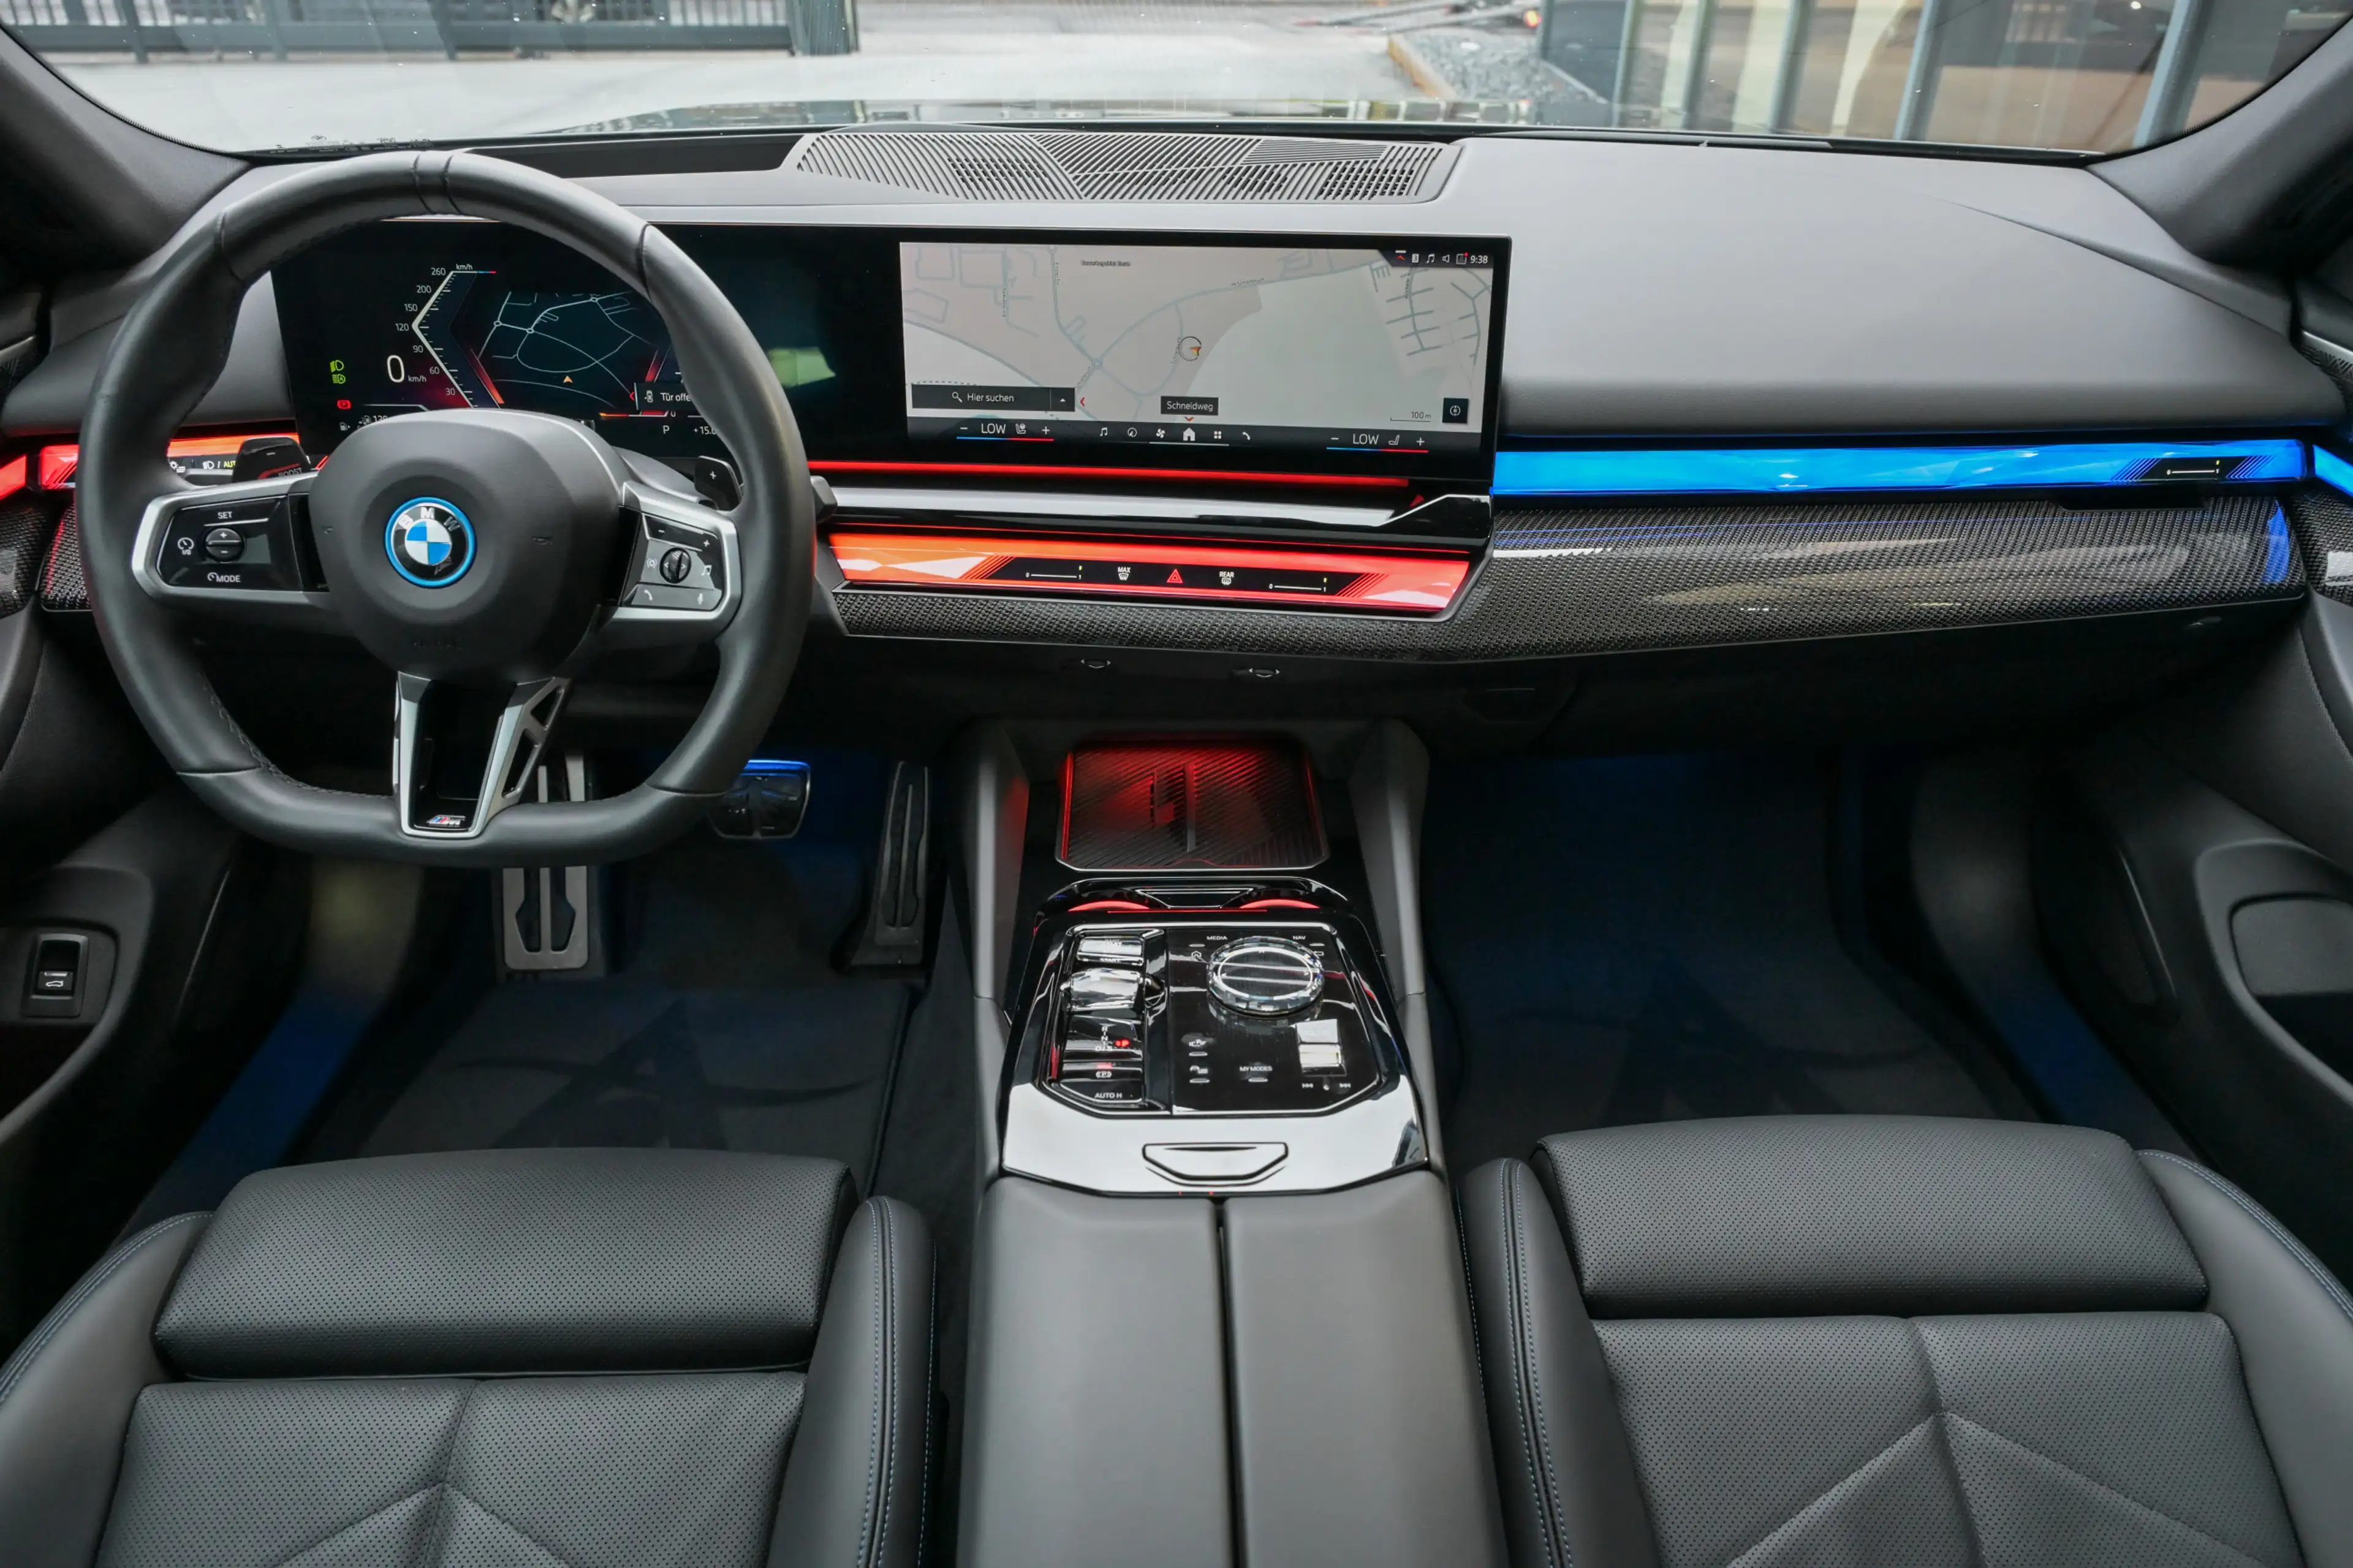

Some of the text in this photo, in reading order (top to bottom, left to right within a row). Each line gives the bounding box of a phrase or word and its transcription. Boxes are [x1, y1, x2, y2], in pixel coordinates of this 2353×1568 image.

[1471, 255, 1488, 264] 9:38
[431, 267, 446, 276] 260
[417, 285, 431, 294] 200
[404, 303, 418, 312] 150
[395, 323, 409, 331] 120
[412, 344, 423, 353] 90
[387, 354, 405, 383] 0
[429, 366, 440, 375] 60
[660, 392, 674, 402] Tür
[967, 393, 1015, 403] Hier suchen
[1166, 401, 1214, 412] Schneidweg
[662, 425, 670, 434] P
[981, 423, 1006, 434] LOW
[1352, 433, 1379, 445] LOW
[218, 511, 233, 520] SET
[398, 506, 460, 532] BMW
